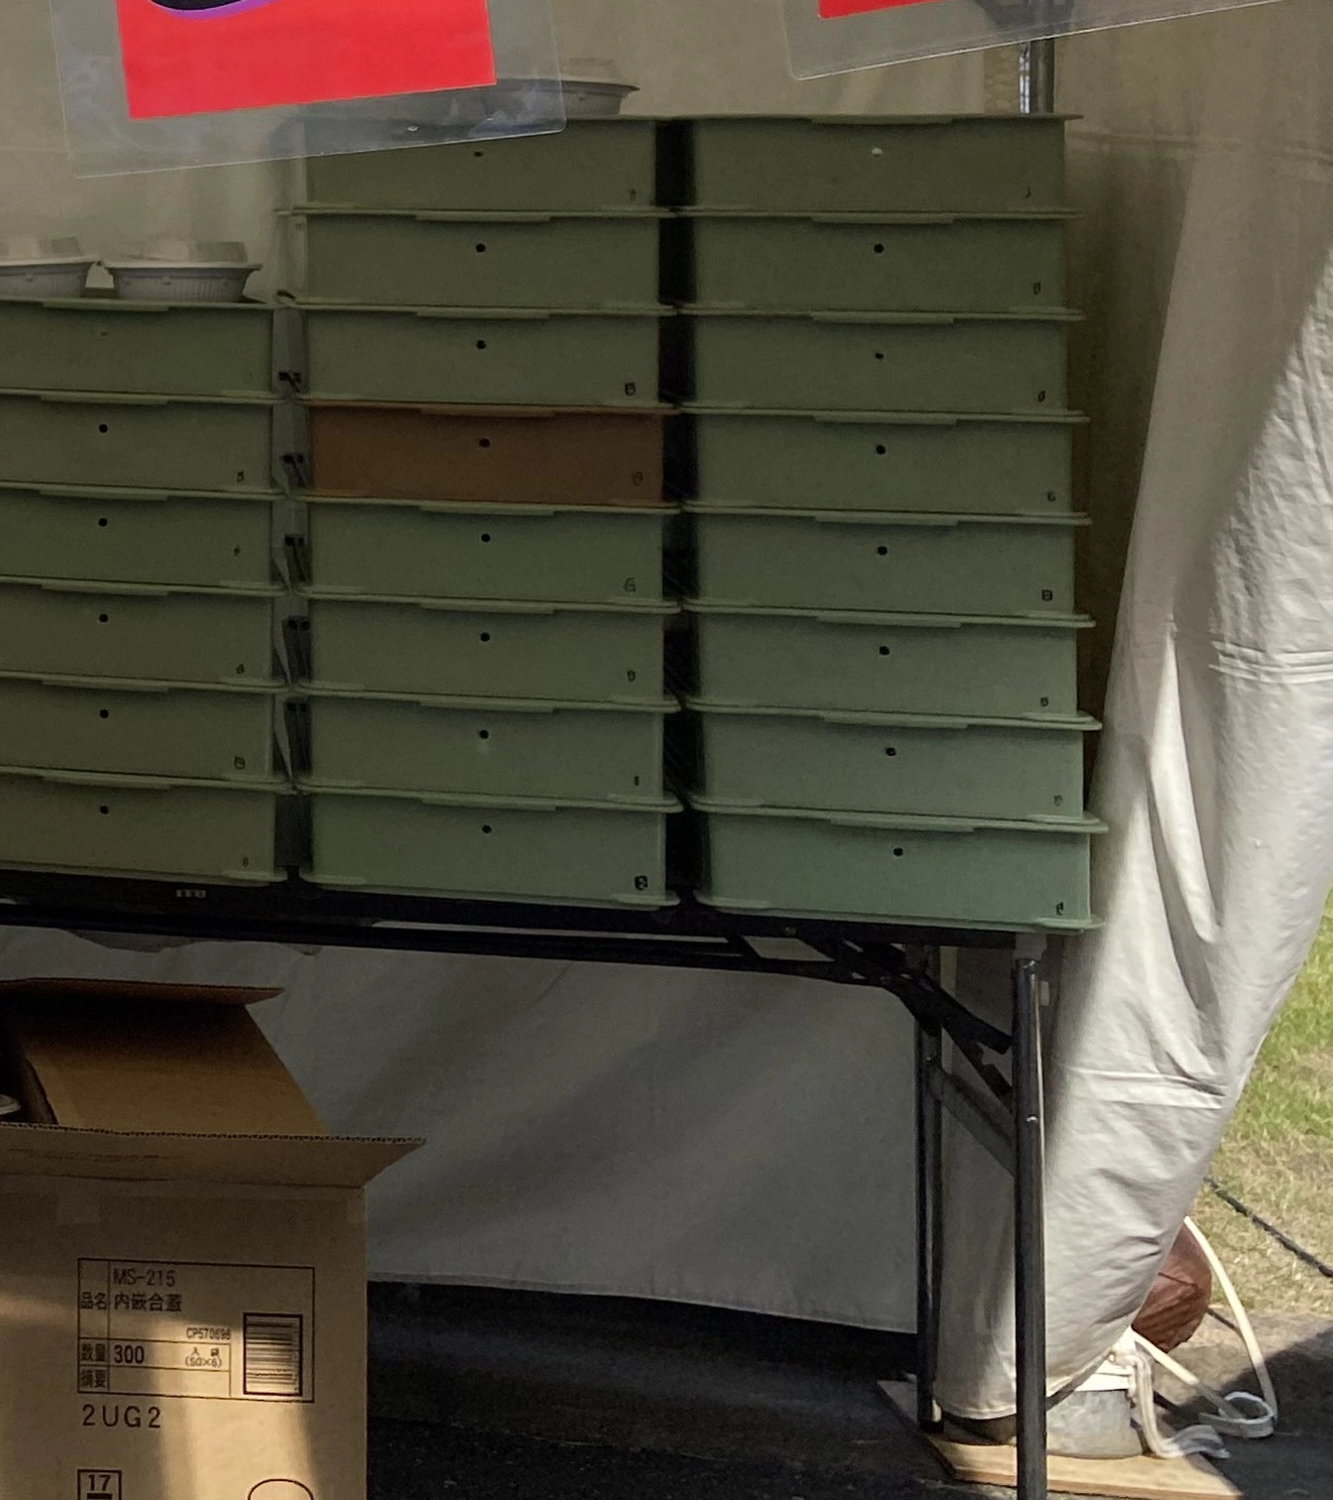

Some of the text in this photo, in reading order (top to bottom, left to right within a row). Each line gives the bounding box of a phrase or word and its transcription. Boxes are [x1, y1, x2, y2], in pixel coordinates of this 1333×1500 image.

[80, 1291, 108, 1311] 品名
[81, 1343, 145, 1364] 数量 300
[82, 1403, 161, 1429] 2UG2
[87, 1473, 112, 1492] 17
